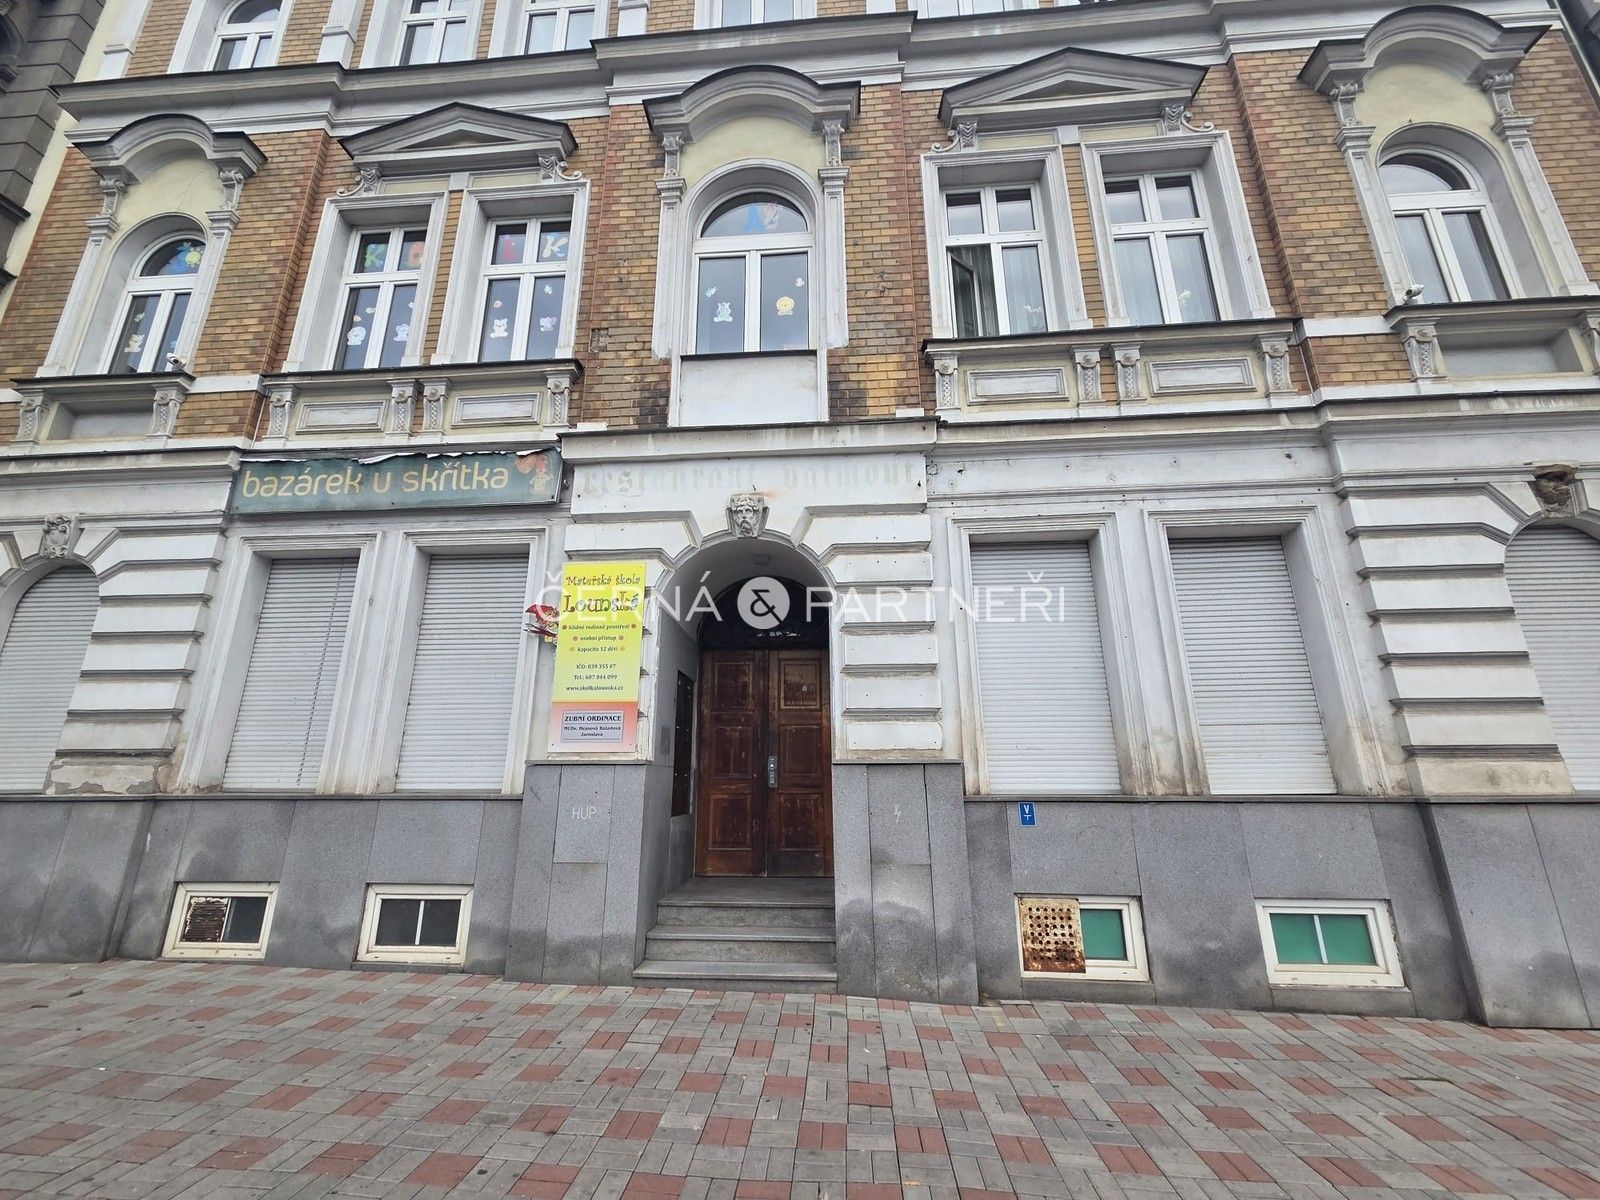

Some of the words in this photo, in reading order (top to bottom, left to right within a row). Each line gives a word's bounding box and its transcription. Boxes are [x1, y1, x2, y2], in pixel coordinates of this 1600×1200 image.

[242, 466, 361, 498] bazárek
[372, 470, 391, 494] u
[403, 461, 509, 493] skřítka
[566, 573, 612, 586] Mateřská
[615, 573, 641, 586] škola
[563, 590, 639, 613] Lounská
[564, 713, 585, 722] ZUBNÍ
[572, 805, 597, 820] HUP
